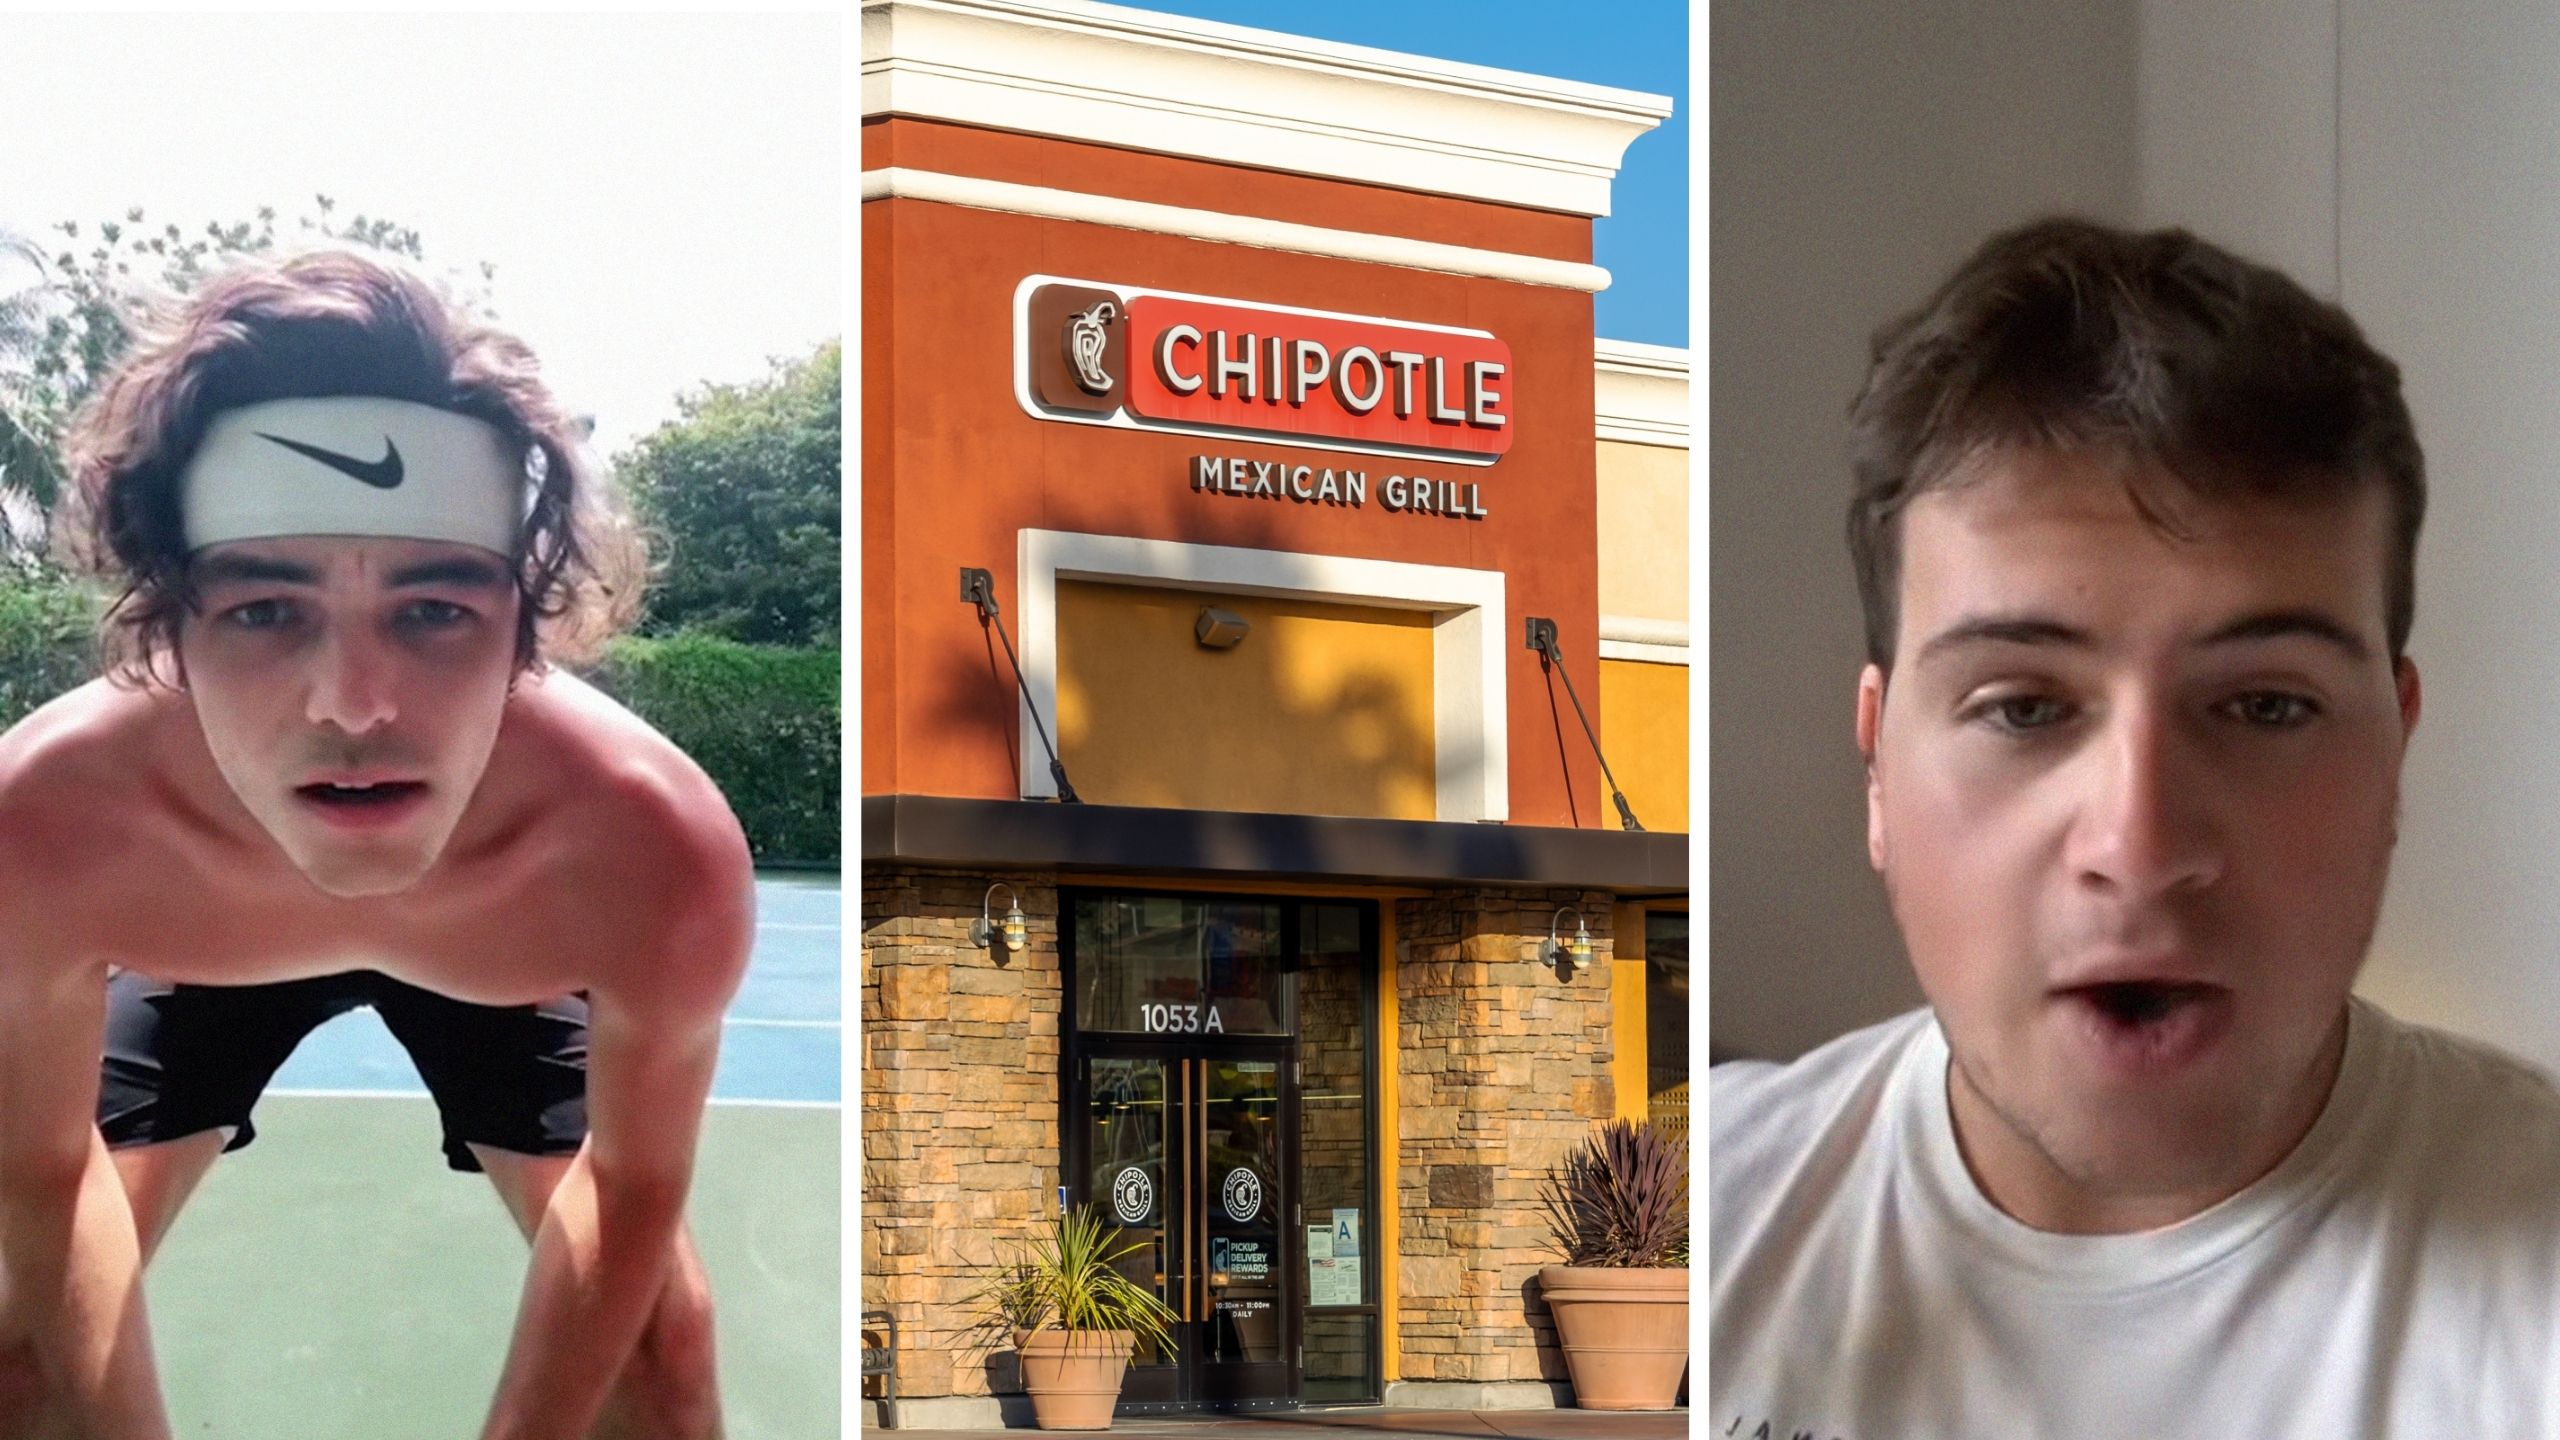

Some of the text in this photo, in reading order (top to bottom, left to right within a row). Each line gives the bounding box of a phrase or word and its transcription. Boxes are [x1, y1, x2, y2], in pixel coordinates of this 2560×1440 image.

[1157, 323, 1507, 426] CHIPOTLE
[1194, 455, 1488, 516] MEXICAN GRILL
[1141, 1003, 1224, 1034] 1053 A
[1117, 1170, 1149, 1191] CHIPOTLE
[1226, 1171, 1258, 1191] CHIPOTLE
[1117, 1199, 1137, 1217] MEXICAN
[1227, 1199, 1246, 1217] MEXICAN
[1338, 1220, 1351, 1240] A
[1230, 1242, 1259, 1252] PICKUP
[1230, 1253, 1268, 1262] DELIVERY
[1230, 1263, 1269, 1273] REWARDS
[1232, 1310, 1253, 1318] DAILY
